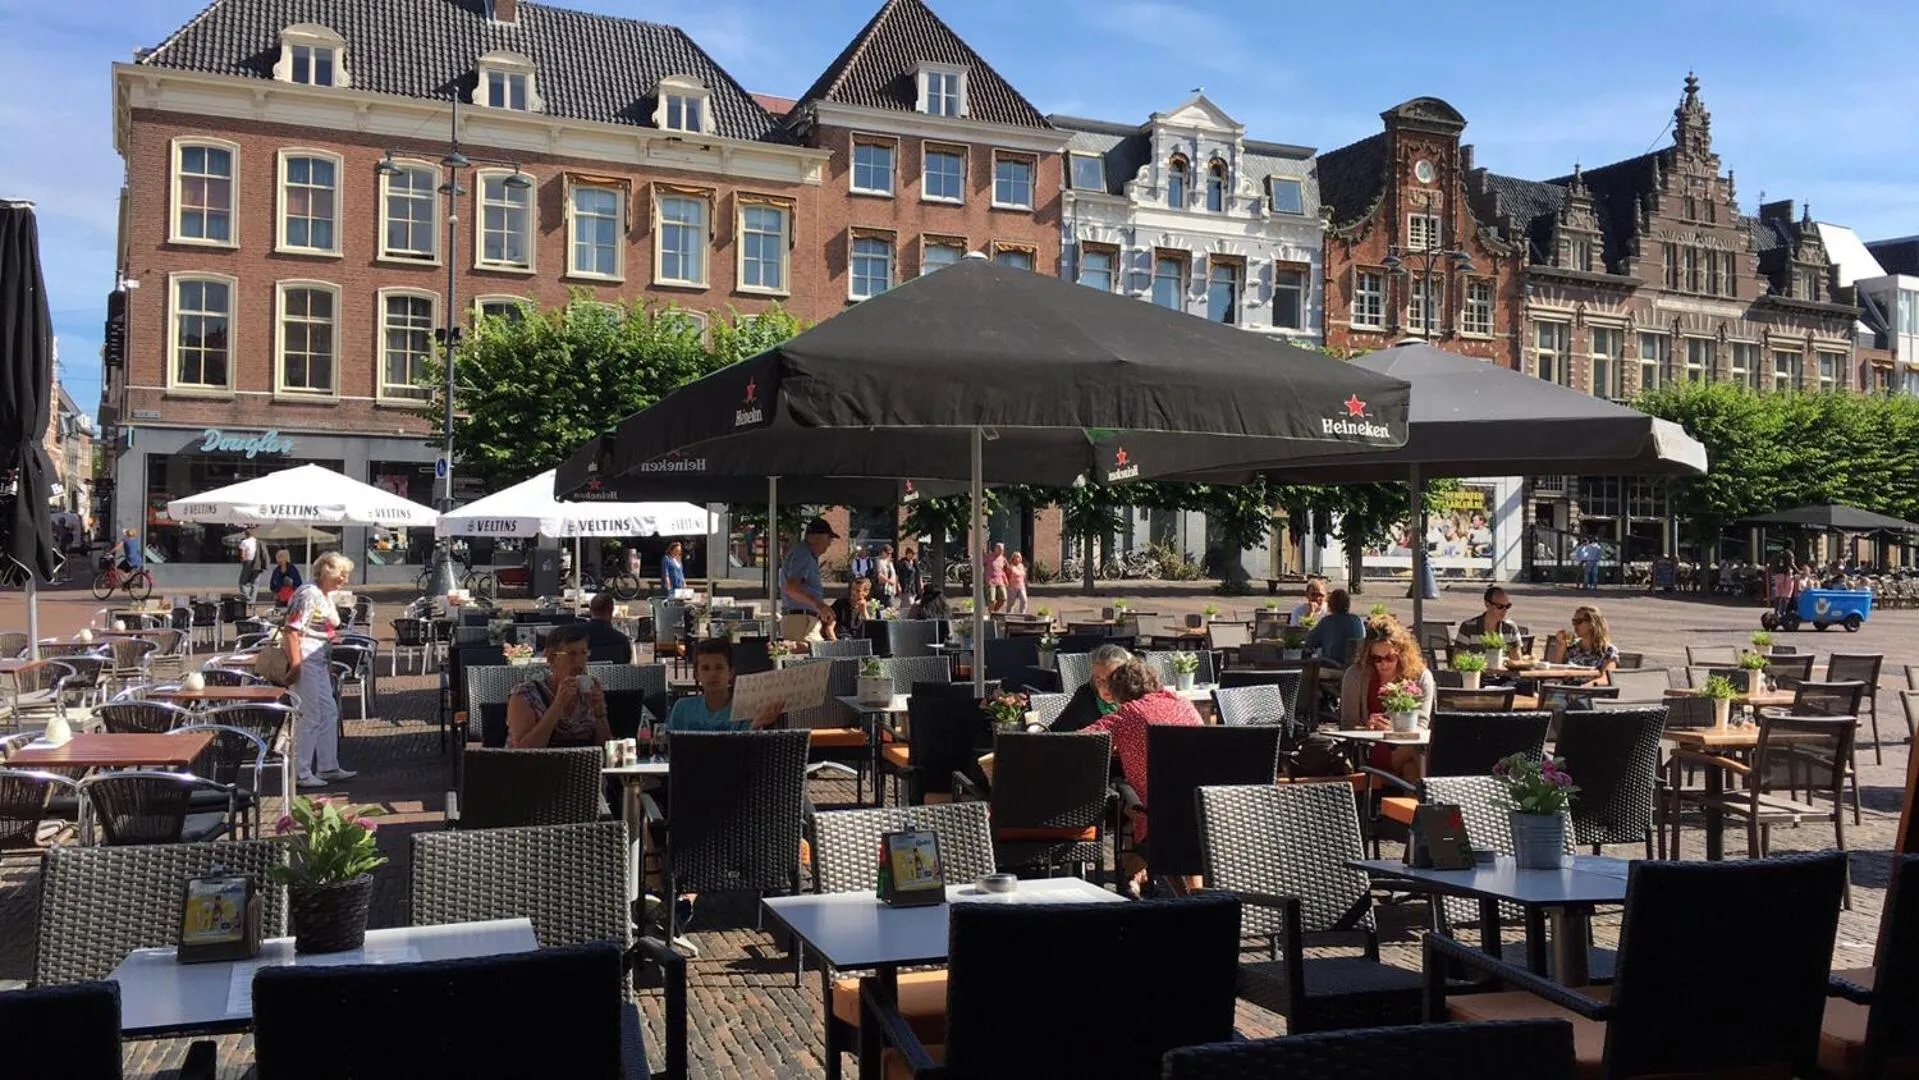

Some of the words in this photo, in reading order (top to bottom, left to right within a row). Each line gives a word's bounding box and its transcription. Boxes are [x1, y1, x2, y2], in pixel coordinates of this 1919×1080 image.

[1321, 418, 1390, 438] Heineken
[201, 428, 292, 459] Douglas
[190, 504, 217, 515] VELTINS
[270, 504, 319, 516] VELTINS
[375, 508, 411, 519] VELTINS
[477, 520, 517, 532] VELTINS
[578, 519, 630, 531] VELTINS
